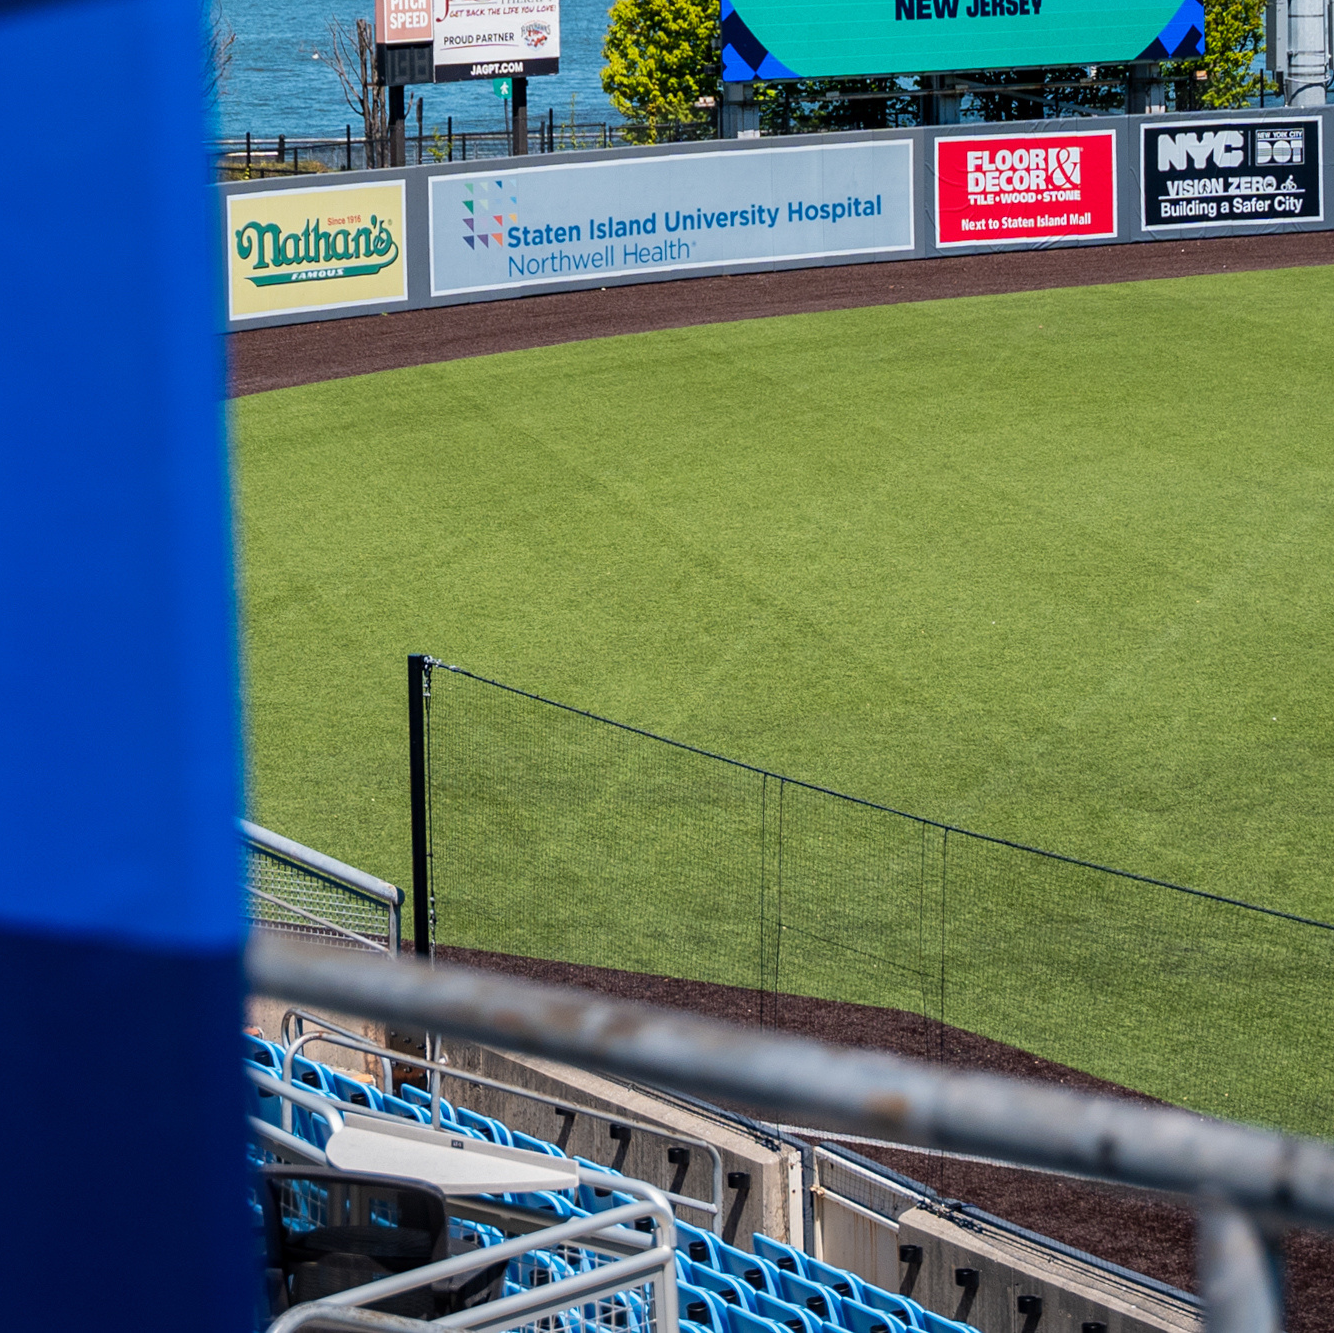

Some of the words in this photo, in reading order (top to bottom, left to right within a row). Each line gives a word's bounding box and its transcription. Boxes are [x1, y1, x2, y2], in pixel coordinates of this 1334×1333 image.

[389, 12, 428, 30] SPEED
[449, 9, 464, 18] GET
[466, 8, 485, 17] BACK
[503, 7, 518, 15] LIFE
[443, 34, 474, 46] PROUD
[476, 32, 515, 43] PARTNER
[470, 62, 523, 76] JAGPT.COM
[1289, 130, 1303, 138] CITY
[967, 148, 1046, 172] FLOOR
[1158, 130, 1244, 172] NYC
[1257, 140, 1303, 164] DOT
[967, 170, 1046, 193] DECOR
[1166, 177, 1224, 196] VISION
[1228, 176, 1277, 194] ZERO
[1160, 200, 1217, 218] Building
[1220, 202, 1229, 213] a
[1233, 198, 1271, 213] Safer
[1274, 196, 1303, 214] City
[327, 217, 346, 226] Since
[347, 215, 361, 224] 1916
[507, 223, 581, 249] Staten
[589, 214, 657, 240] Island
[664, 202, 780, 233] University
[788, 194, 882, 224] Hospital
[961, 218, 986, 231] Next
[988, 218, 1000, 229] to
[1002, 216, 1034, 229] Staten
[1037, 213, 1067, 227] Island
[1069, 212, 1092, 225] Mall
[235, 214, 395, 269] Nathan's
[508, 245, 614, 277] Northwell
[623, 238, 690, 265] Health
[291, 268, 344, 280] FAMOUS
